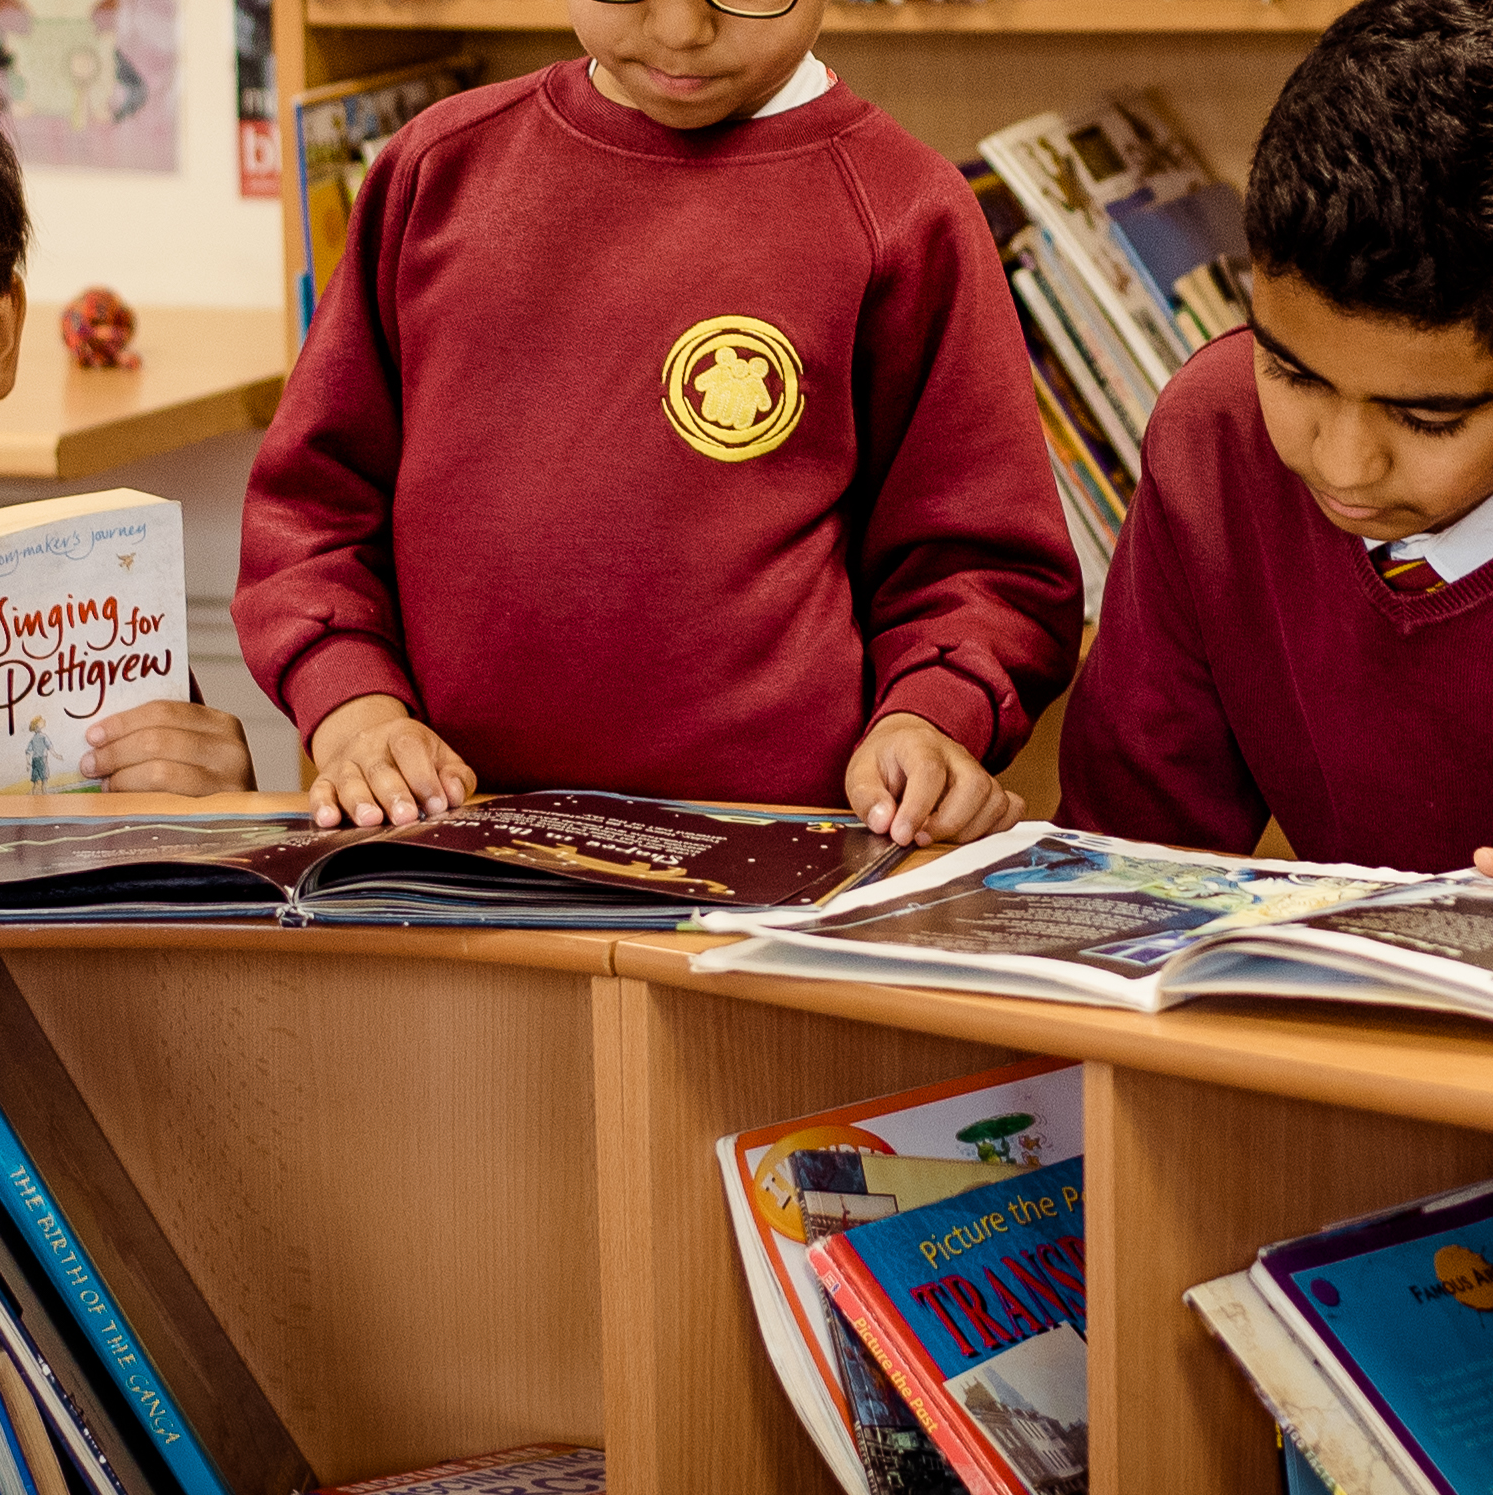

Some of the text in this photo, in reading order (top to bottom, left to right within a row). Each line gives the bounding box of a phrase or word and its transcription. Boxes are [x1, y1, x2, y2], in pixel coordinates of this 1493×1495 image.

[65, 522, 147, 561] journey
[120, 606, 166, 647] for
[919, 1210, 1010, 1271] Picture
[1008, 1194, 1058, 1226] the
[9, 1164, 45, 1212] THE
[36, 1213, 89, 1287] BIRTH
[79, 1288, 107, 1317] OF
[100, 1319, 137, 1371] THE
[1408, 1275, 1475, 1305] FAMOUS
[853, 1316, 939, 1434] Picture the Past
